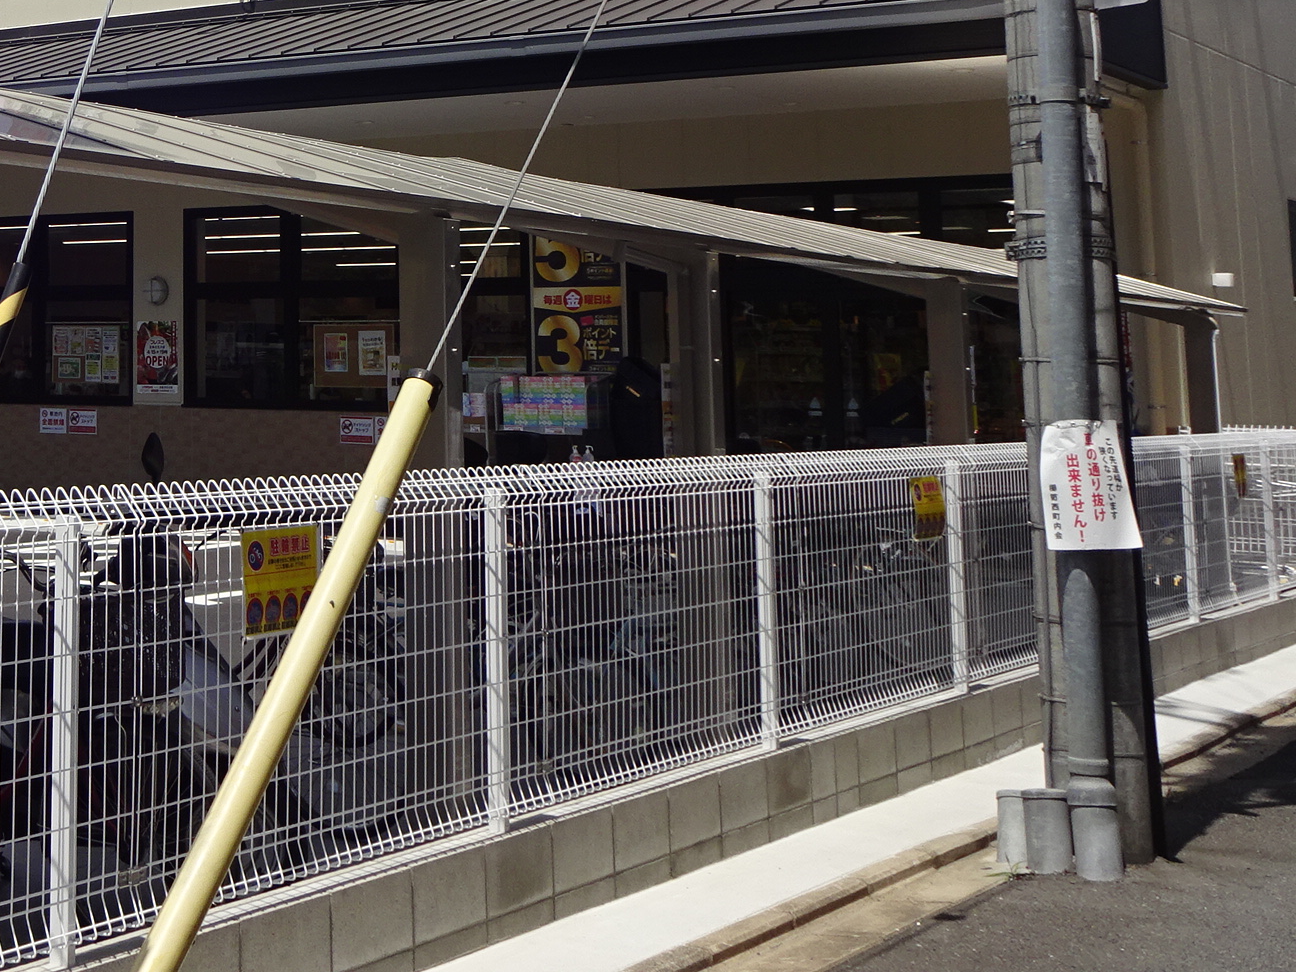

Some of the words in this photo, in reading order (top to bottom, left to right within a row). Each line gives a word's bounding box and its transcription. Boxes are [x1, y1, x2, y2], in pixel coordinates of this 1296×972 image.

[145, 355, 169, 366] OPEN
[537, 314, 584, 372] 3
[1083, 432, 1106, 523] 車の通り抜け
[269, 534, 310, 557] 駐輪禁止
